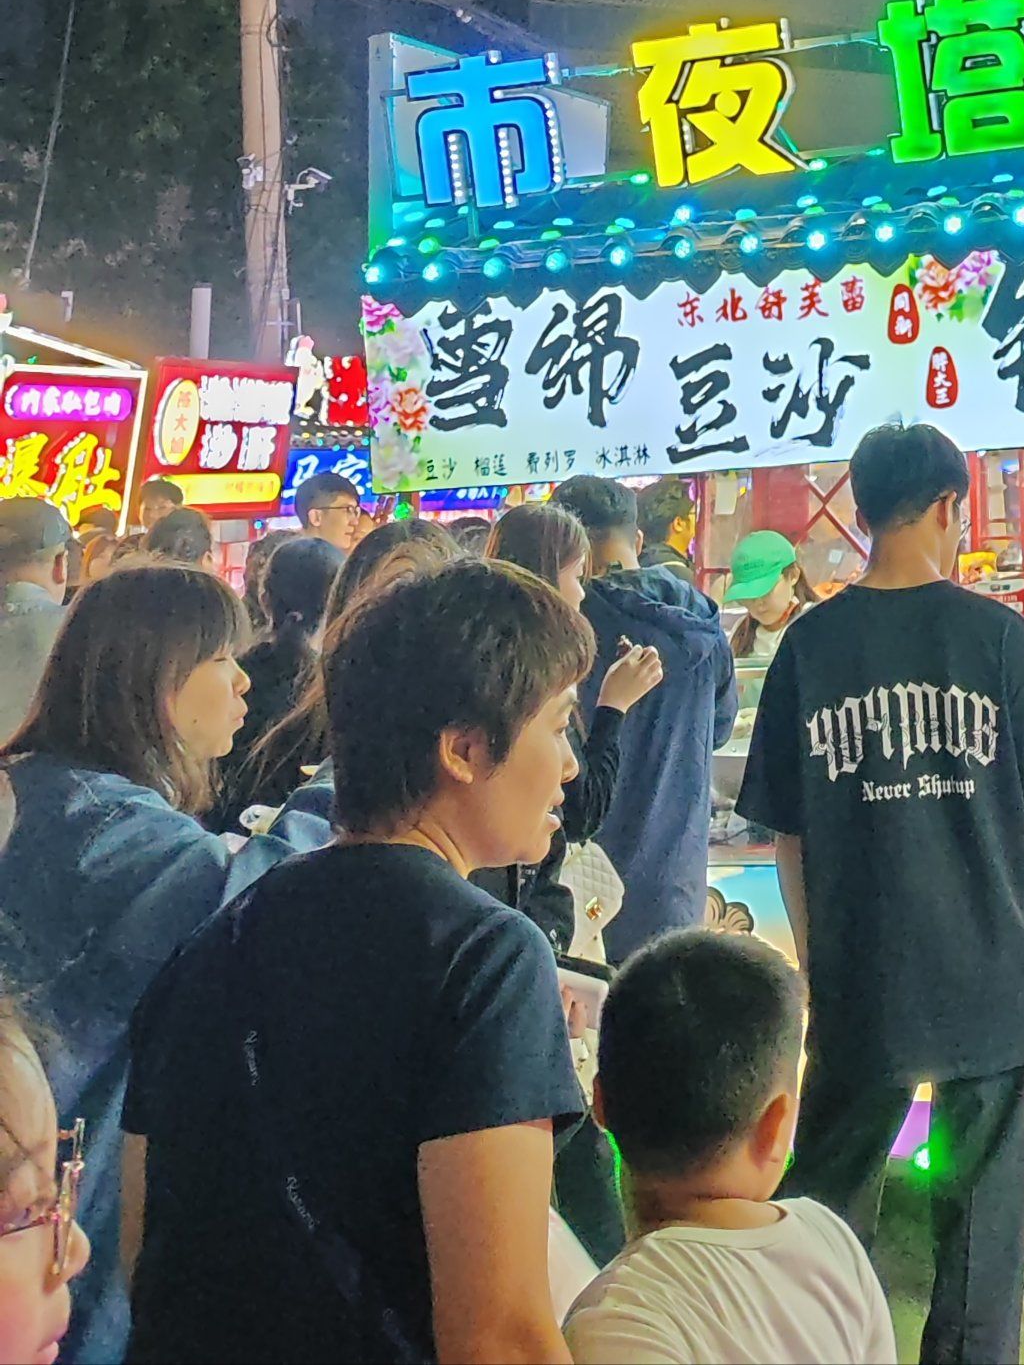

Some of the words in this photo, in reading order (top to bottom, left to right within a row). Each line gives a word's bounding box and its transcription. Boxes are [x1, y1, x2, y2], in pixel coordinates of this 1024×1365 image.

[425, 458, 458, 481] 豆沙
[474, 453, 508, 477] 榴莲
[527, 449, 577, 474] 费列罗
[596, 443, 651, 470] 冰淇淋
[862, 780, 912, 803] Never
